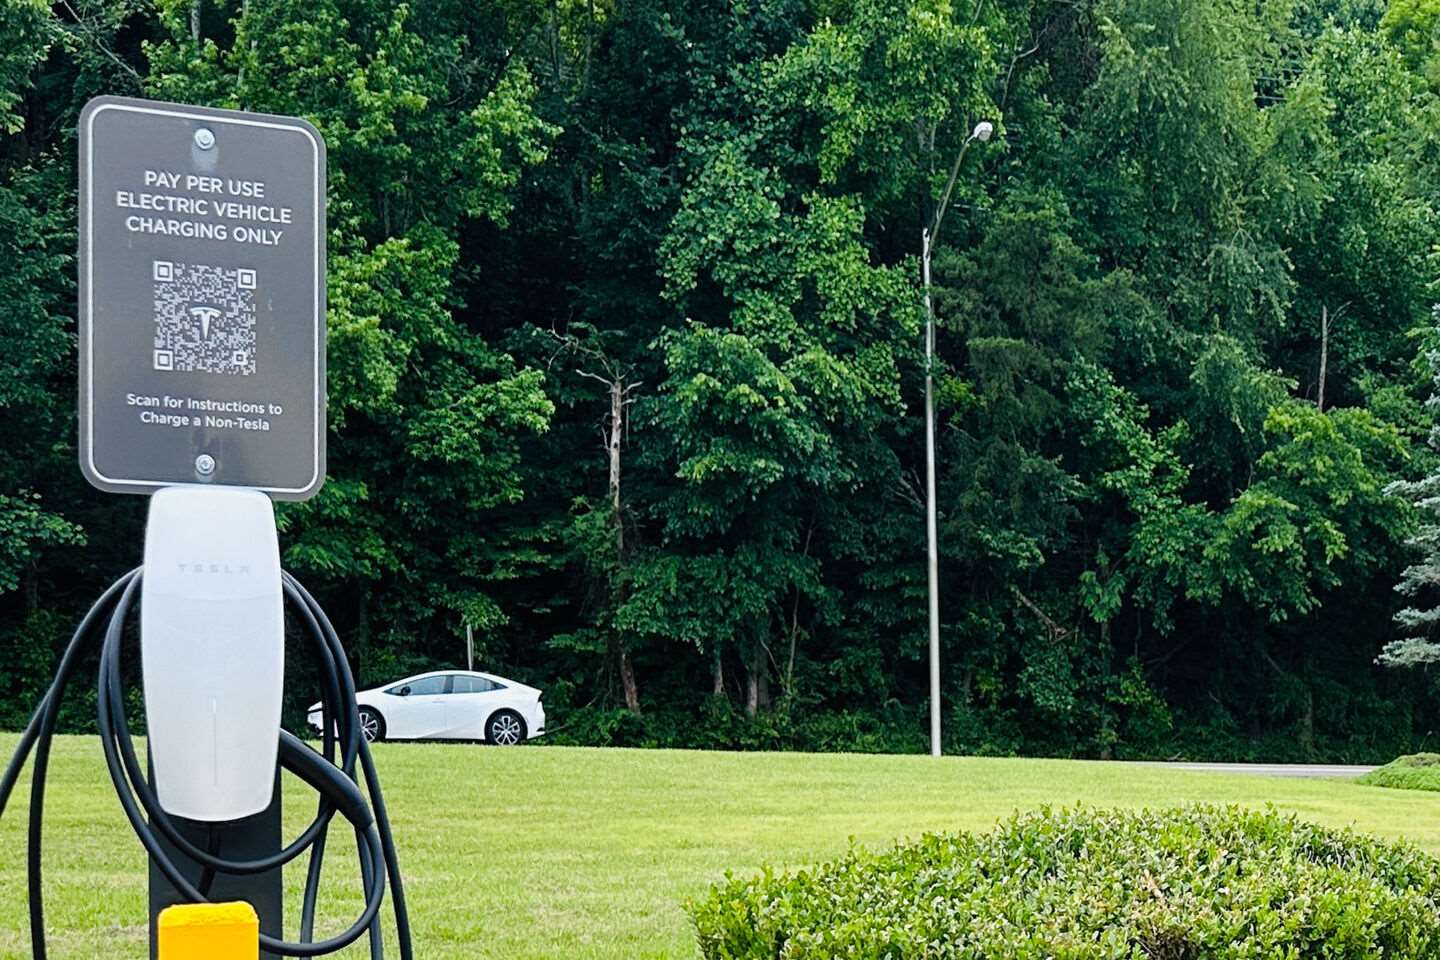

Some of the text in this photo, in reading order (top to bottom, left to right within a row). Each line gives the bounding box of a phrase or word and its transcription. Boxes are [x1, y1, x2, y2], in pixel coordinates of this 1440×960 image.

[144, 170, 265, 198] PAY PER USE
[116, 191, 292, 224] ELECTRIC VEHICLE
[126, 216, 282, 246] CHARGING ONLY
[126, 393, 283, 415] Scan for Instructions to
[140, 411, 270, 431] Charge a Non-Tesla
[178, 564, 249, 574] TESLA
